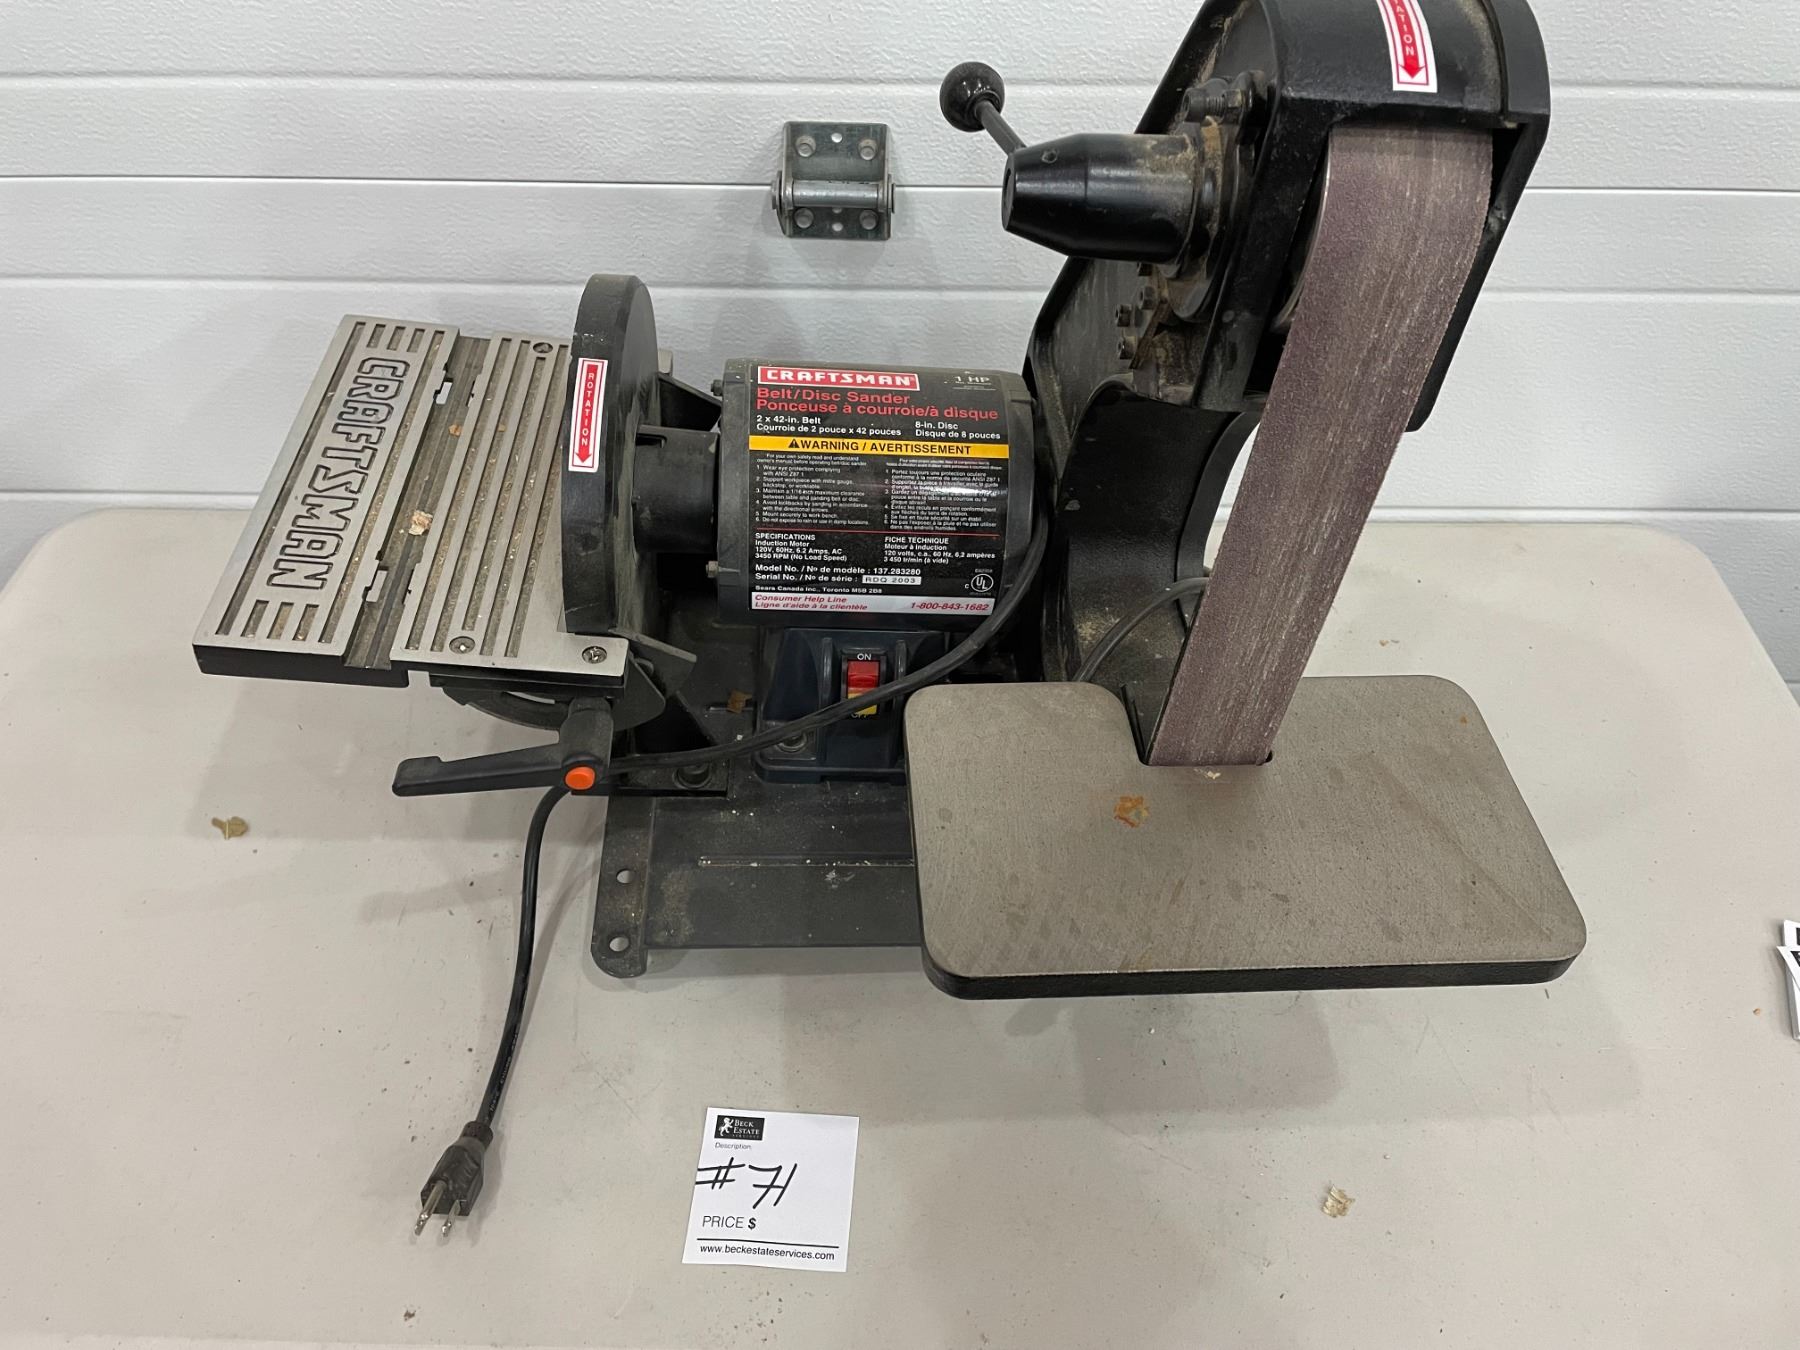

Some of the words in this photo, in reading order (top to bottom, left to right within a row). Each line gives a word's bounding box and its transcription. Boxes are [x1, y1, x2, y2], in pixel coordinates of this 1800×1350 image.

[766, 370, 910, 386] CRAFTSMAN
[757, 387, 840, 401] Belt/Disc
[847, 391, 910, 404] Sander
[582, 372, 594, 446] ROTATION
[757, 399, 837, 413] Ponceuse
[857, 405, 938, 417] courroie/à
[944, 406, 998, 421] disque
[756, 423, 795, 432] Courroie
[915, 429, 946, 438] Disque
[800, 440, 858, 450] WARNING
[870, 442, 971, 454] AVERTISSEMENT
[265, 356, 410, 591] CRAFTSMAN
[911, 603, 990, 611] 1-800-843-1682
[734, 1119, 754, 1127] BECK
[702, 1215, 744, 1228] PRICE
[748, 1218, 757, 1230] $
[700, 1244, 835, 1260] www.beckestateservices.com
